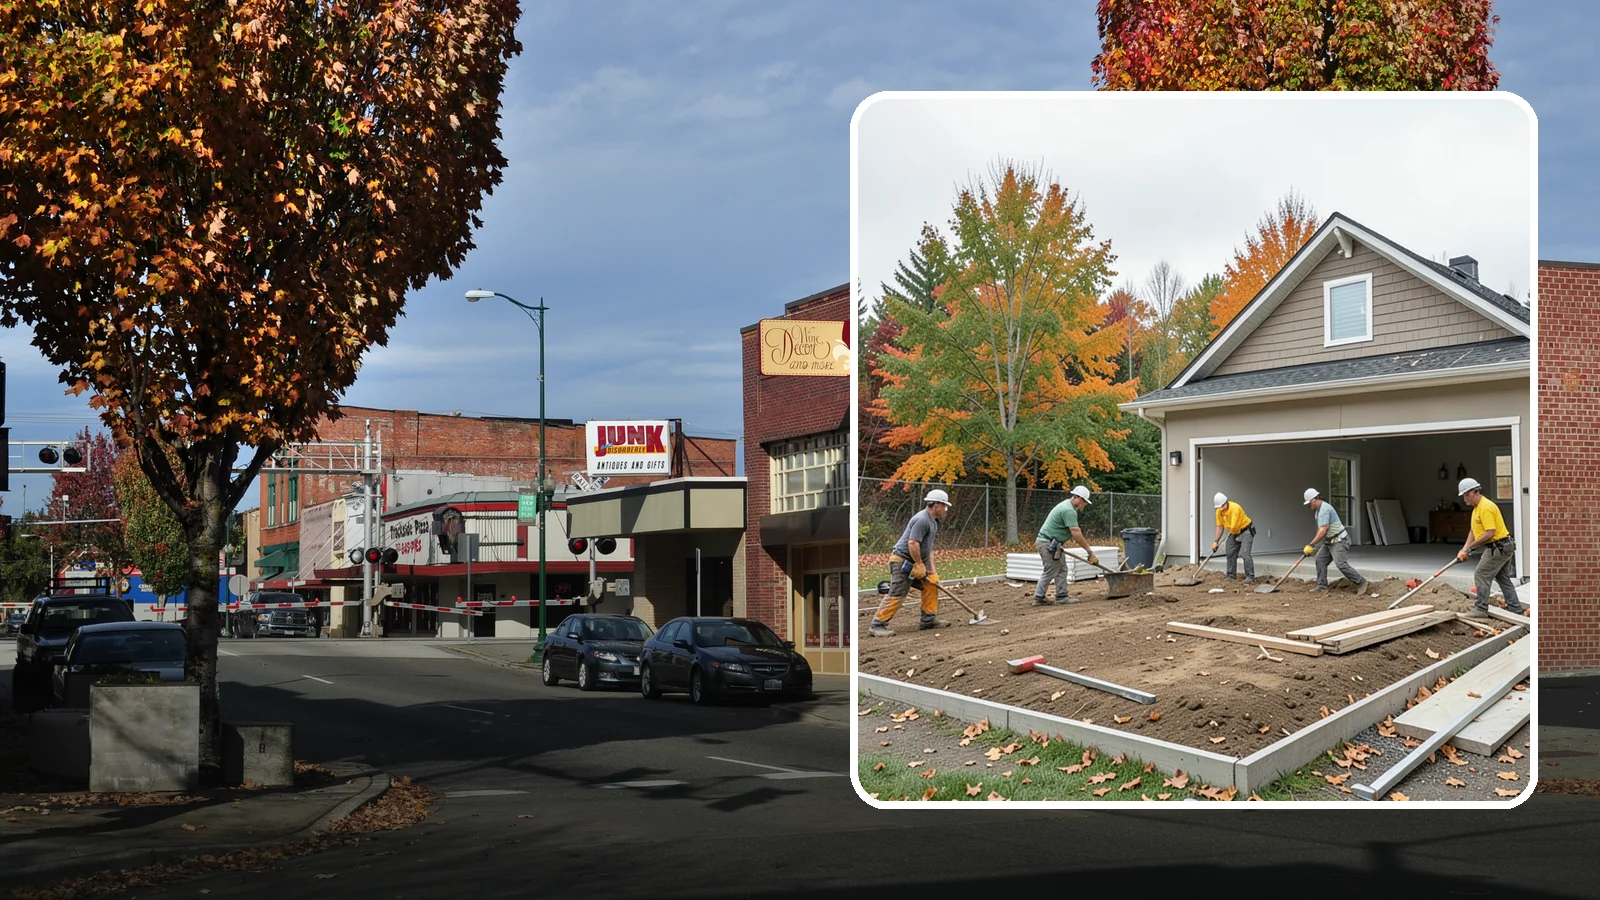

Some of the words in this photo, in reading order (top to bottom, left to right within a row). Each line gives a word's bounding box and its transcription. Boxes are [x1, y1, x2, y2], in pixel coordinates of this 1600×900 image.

[595, 425, 665, 457] JUNK
[607, 446, 646, 454] DISORDERLY
[597, 461, 628, 470] ANTIQUES
[631, 461, 644, 470] AND
[647, 460, 665, 470] GIFTS
[352, 497, 365, 511] CRO
[390, 521, 413, 539] Trackside
[415, 519, 429, 534] Pizza
